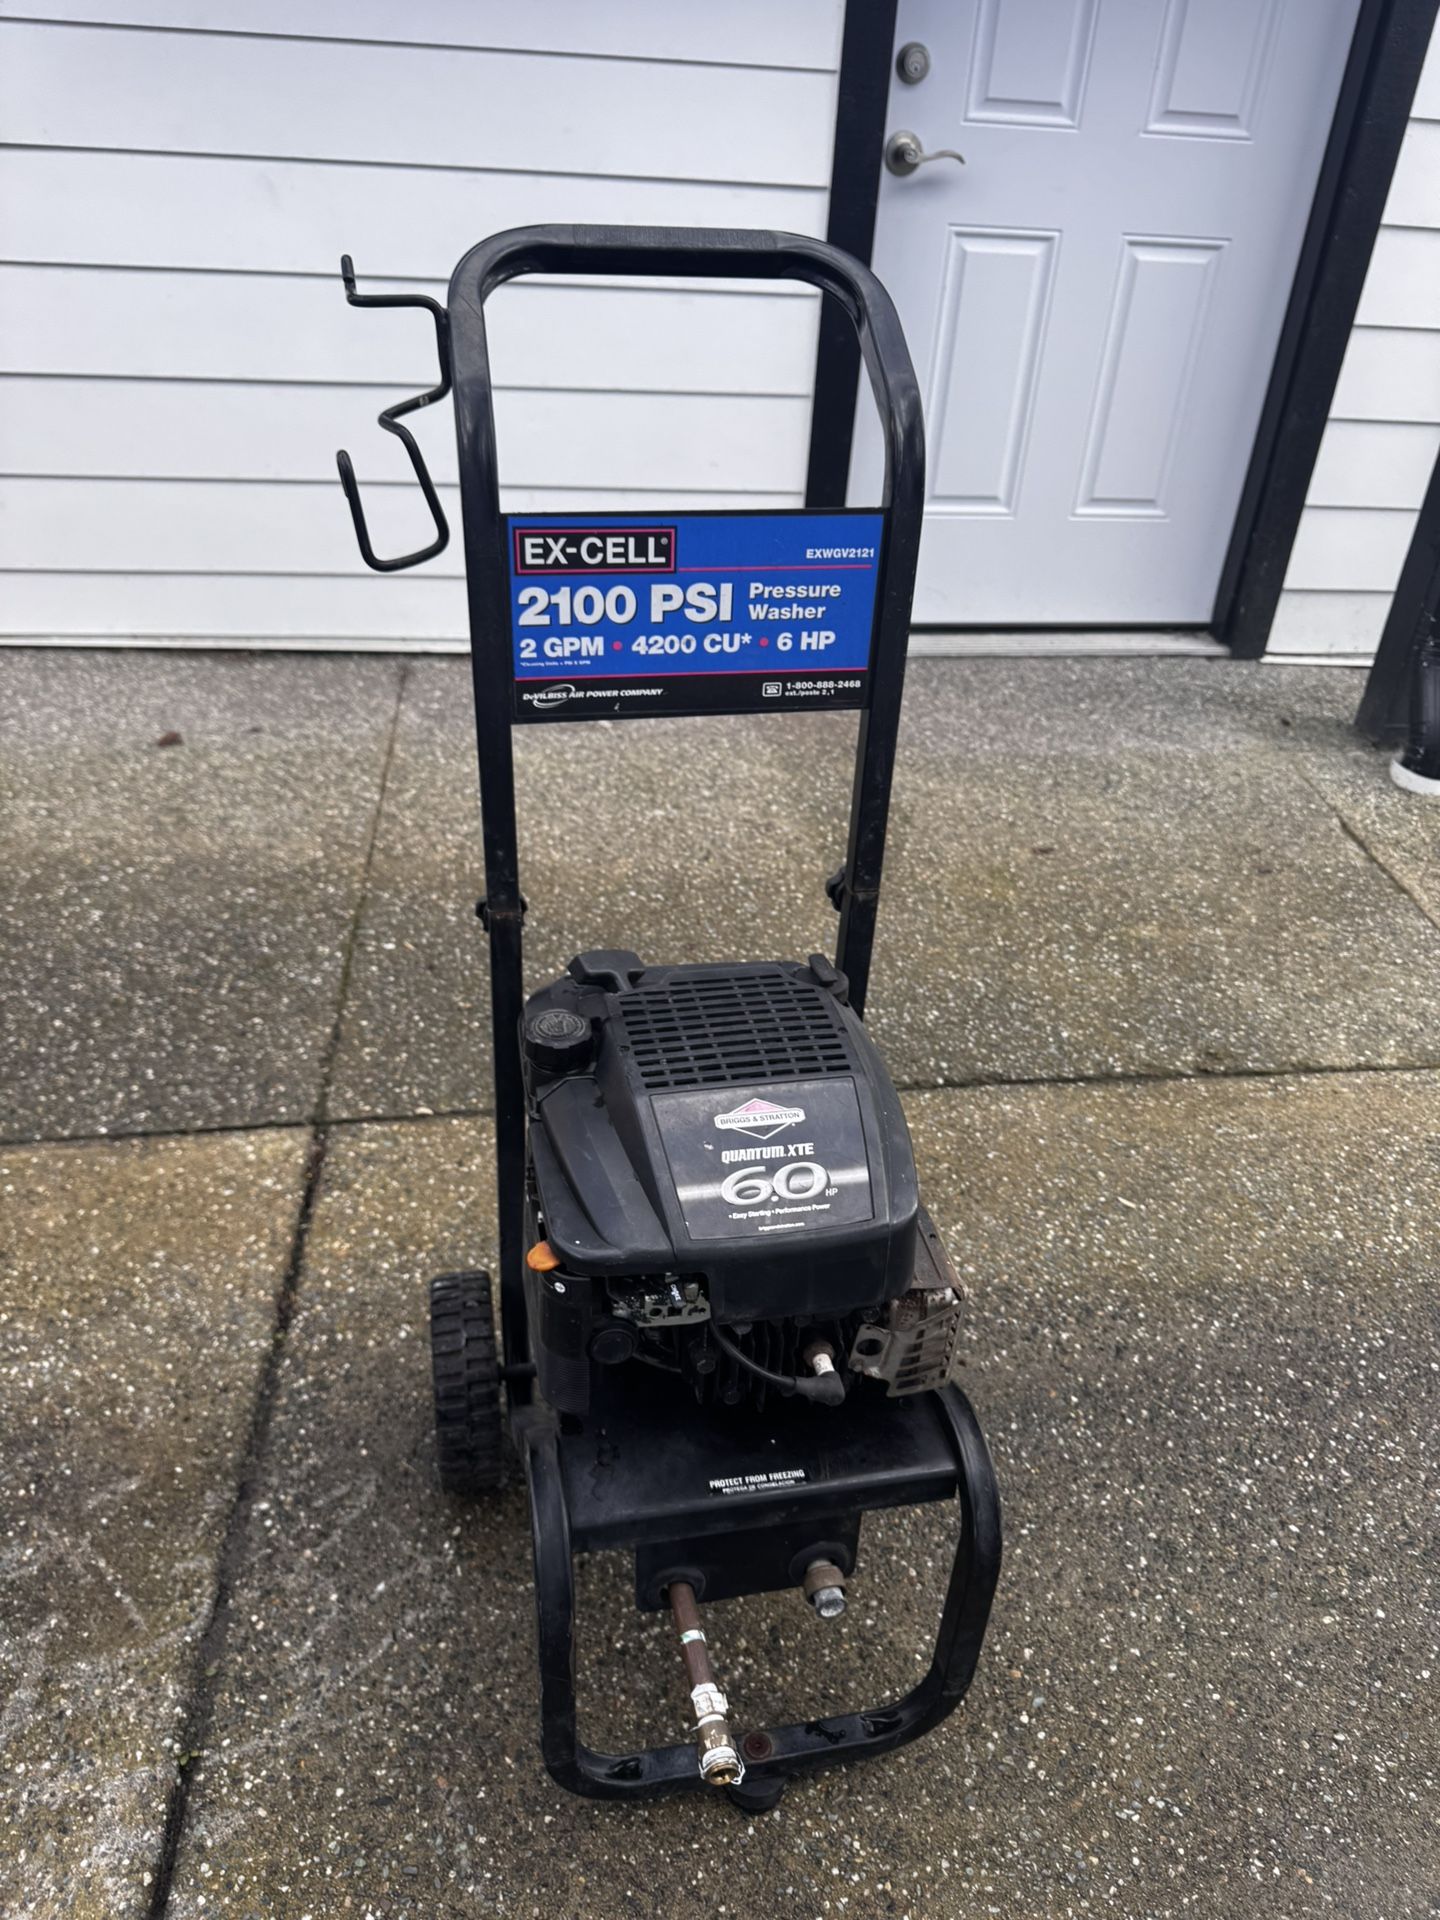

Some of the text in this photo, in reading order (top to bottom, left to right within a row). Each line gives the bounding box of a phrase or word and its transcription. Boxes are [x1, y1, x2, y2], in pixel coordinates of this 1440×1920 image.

[806, 548, 875, 560] EXWGV2121
[749, 582, 841, 599] Pressure
[518, 582, 733, 625] 2100 PSI
[749, 603, 826, 621] Washer
[520, 639, 538, 658] 2
[543, 636, 604, 658] GPM
[631, 634, 697, 655] 4200
[776, 632, 792, 651] 6
[800, 631, 836, 650] HP
[569, 690, 584, 699] AIR
[586, 689, 619, 698] POWER
[620, 688, 663, 697] COMPANY
[786, 680, 861, 690] 1-800-888-2468
[720, 1116, 751, 1125] BRIGGS
[760, 1112, 801, 1122] STRATTON
[787, 1143, 815, 1157] XTE
[721, 1162, 838, 1206] 6.0 HP
[709, 1469, 805, 1489] PROTECT FROM FREEZING
